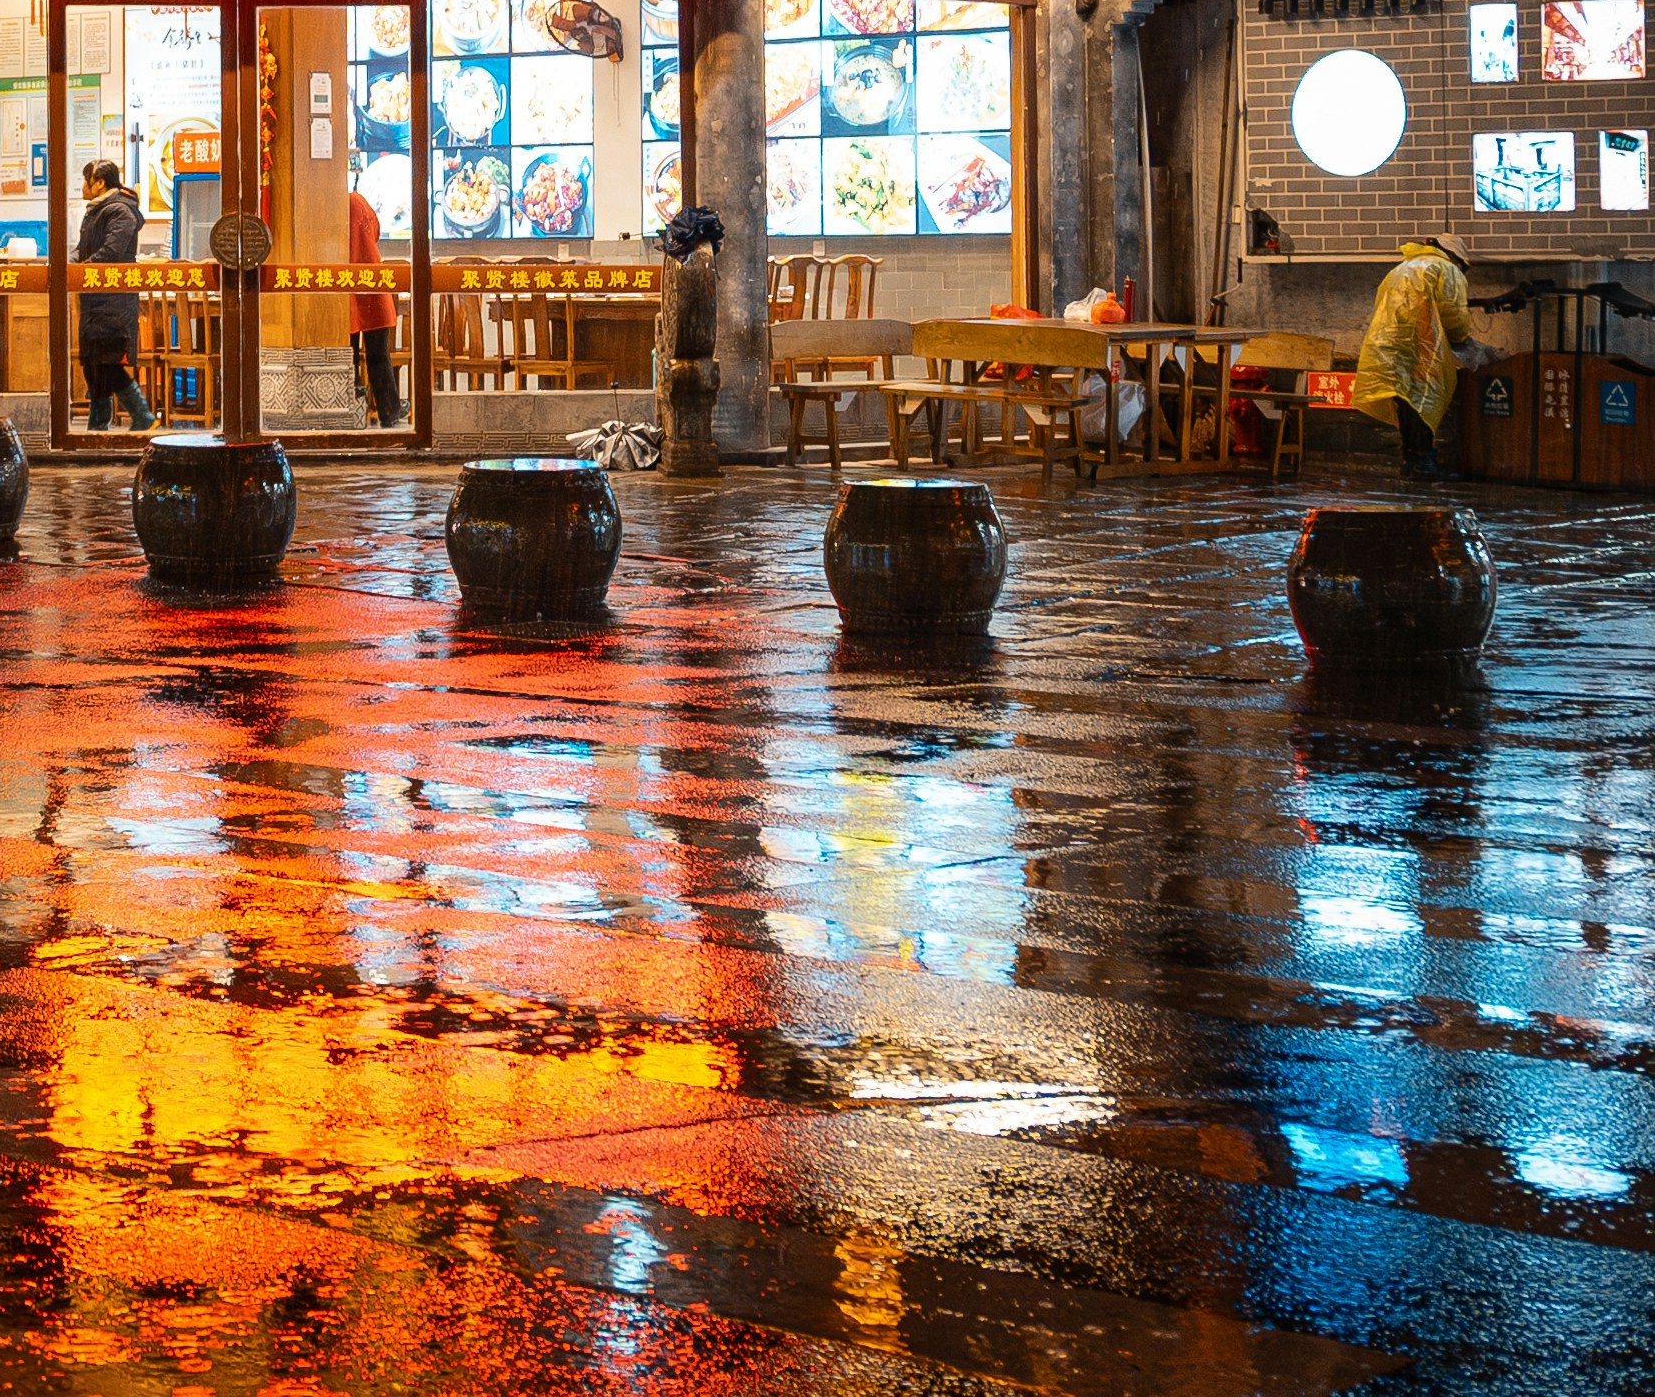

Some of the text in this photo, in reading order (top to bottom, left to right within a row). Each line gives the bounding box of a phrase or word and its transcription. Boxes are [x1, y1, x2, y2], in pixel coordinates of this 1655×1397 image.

[83, 267, 207, 289] 聚贤楼欢迎您
[273, 267, 398, 290] 聚贤楼欢迎您
[460, 269, 655, 290] 聚贤楼徽菜品牌店
[1318, 375, 1340, 390] 室外
